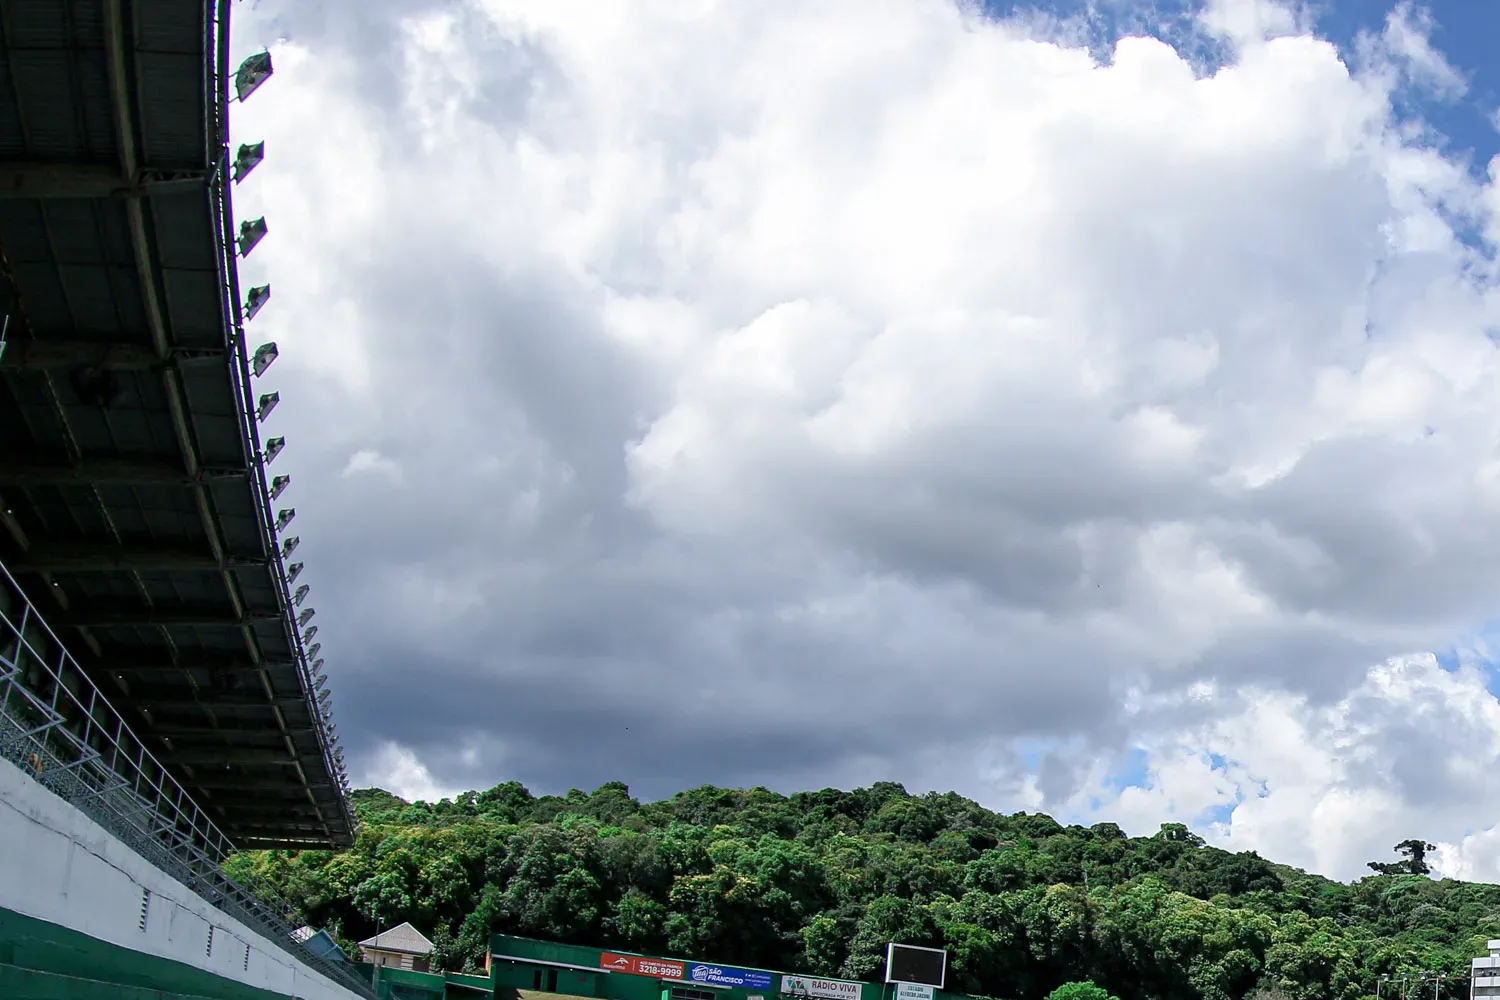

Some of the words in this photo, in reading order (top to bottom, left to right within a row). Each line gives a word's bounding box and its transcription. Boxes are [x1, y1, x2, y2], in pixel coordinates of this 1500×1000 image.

[639, 965, 682, 977] 3218-9999
[707, 976, 743, 985] FRANCISCO
[839, 983, 857, 993] VIVA
